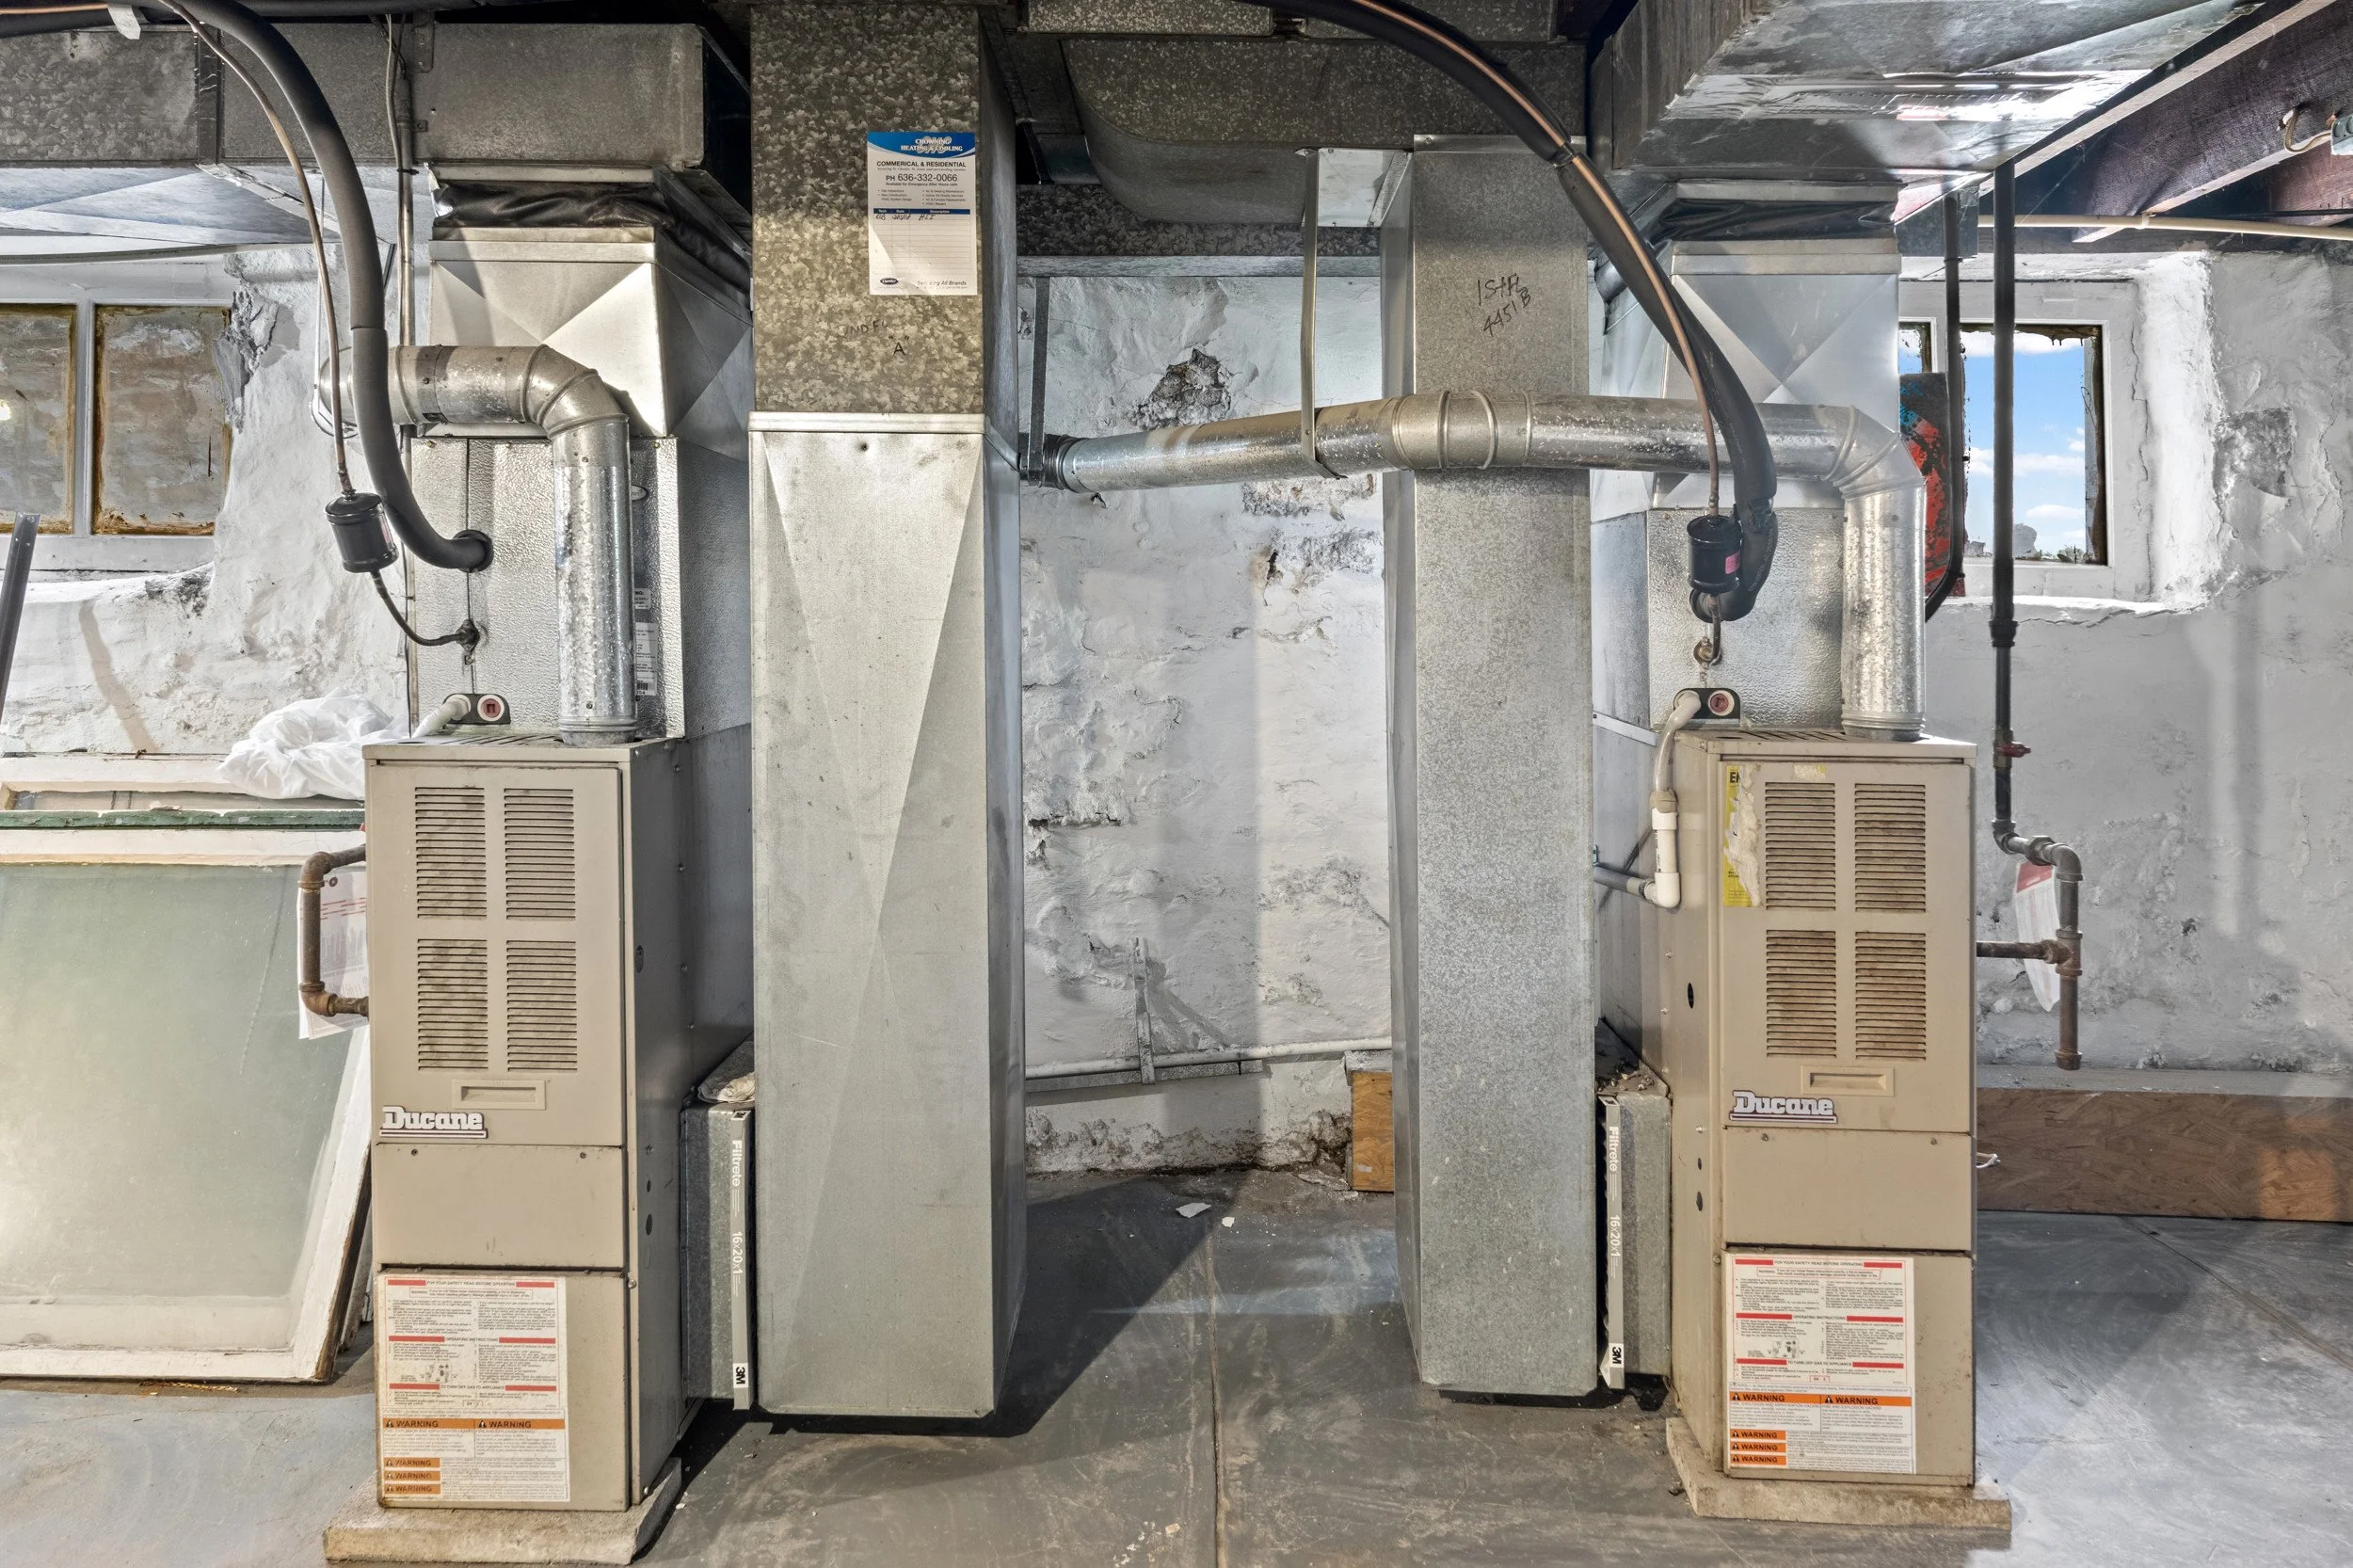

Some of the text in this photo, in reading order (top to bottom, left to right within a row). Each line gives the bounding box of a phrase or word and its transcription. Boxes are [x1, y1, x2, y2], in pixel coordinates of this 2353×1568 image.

[898, 173, 958, 182] 636-332-0066
[1732, 1090, 1834, 1116] Ducane
[381, 1105, 485, 1130] Ducane
[1609, 1126, 1620, 1172] Filtrete
[731, 1140, 743, 1187] Filtrete
[1609, 1214, 1621, 1257] 16x20x1
[732, 1231, 744, 1274] 16x20x1
[1611, 1346, 1622, 1365] 3M
[735, 1366, 746, 1384] 3M
[1742, 1394, 1785, 1402] WARNING
[1835, 1397, 1879, 1405] WARNING
[396, 1419, 439, 1429] WARNING
[488, 1420, 532, 1429] WARNING
[395, 1459, 432, 1467] WARNING
[1741, 1455, 1778, 1464] WARNING
[395, 1484, 432, 1493] WARNING
